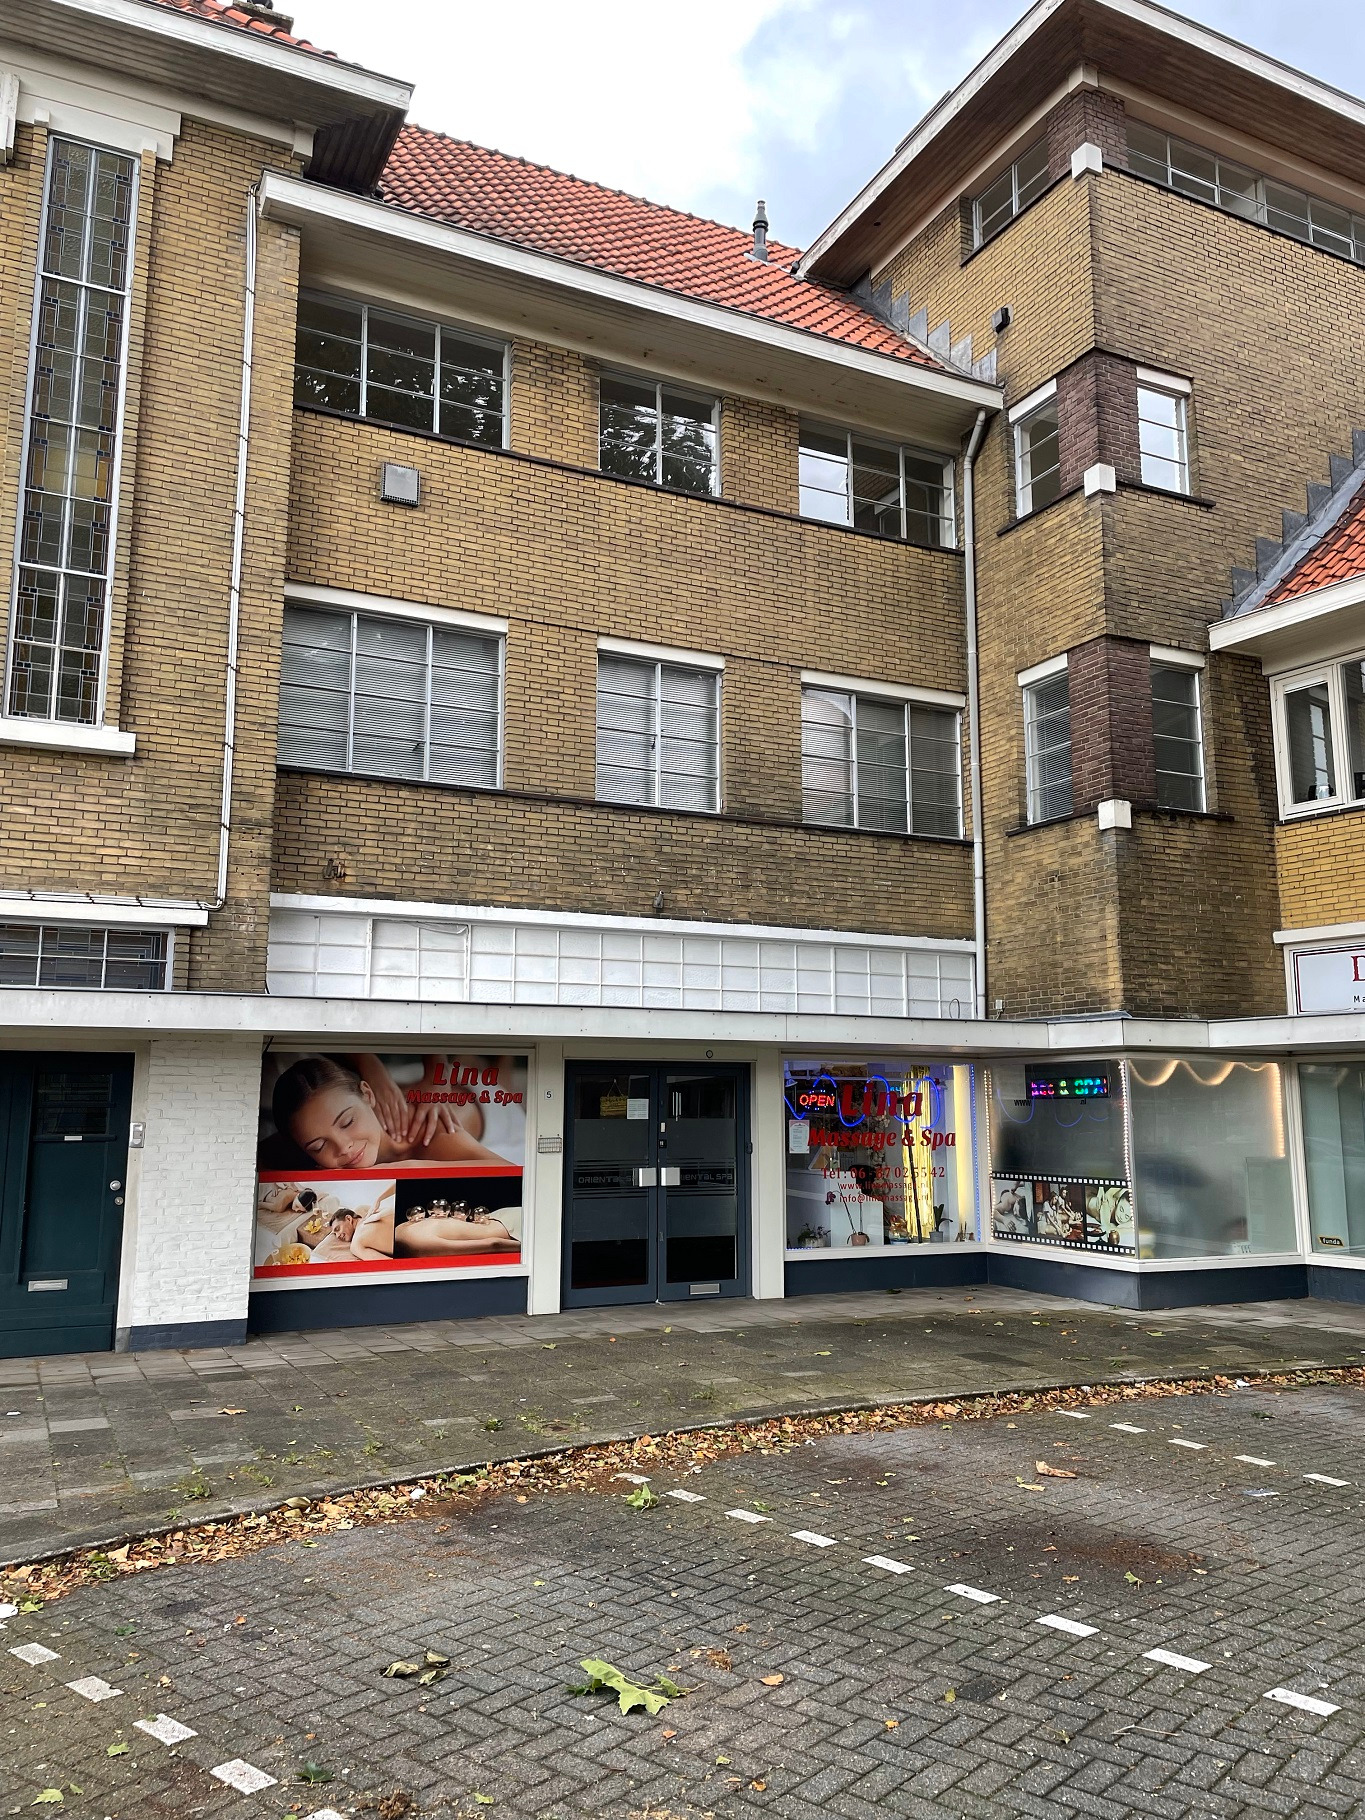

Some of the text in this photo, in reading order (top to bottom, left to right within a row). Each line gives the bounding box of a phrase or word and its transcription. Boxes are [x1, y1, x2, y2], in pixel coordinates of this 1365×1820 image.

[433, 1061, 500, 1086] Lina
[406, 1089, 524, 1107] Massage & Spa
[546, 1090, 552, 1099] 5
[799, 1094, 836, 1106] OPEN
[841, 1083, 923, 1117] Lina
[808, 1128, 897, 1151] Massage
[901, 1129, 915, 1147] &
[920, 1129, 956, 1151] Spa
